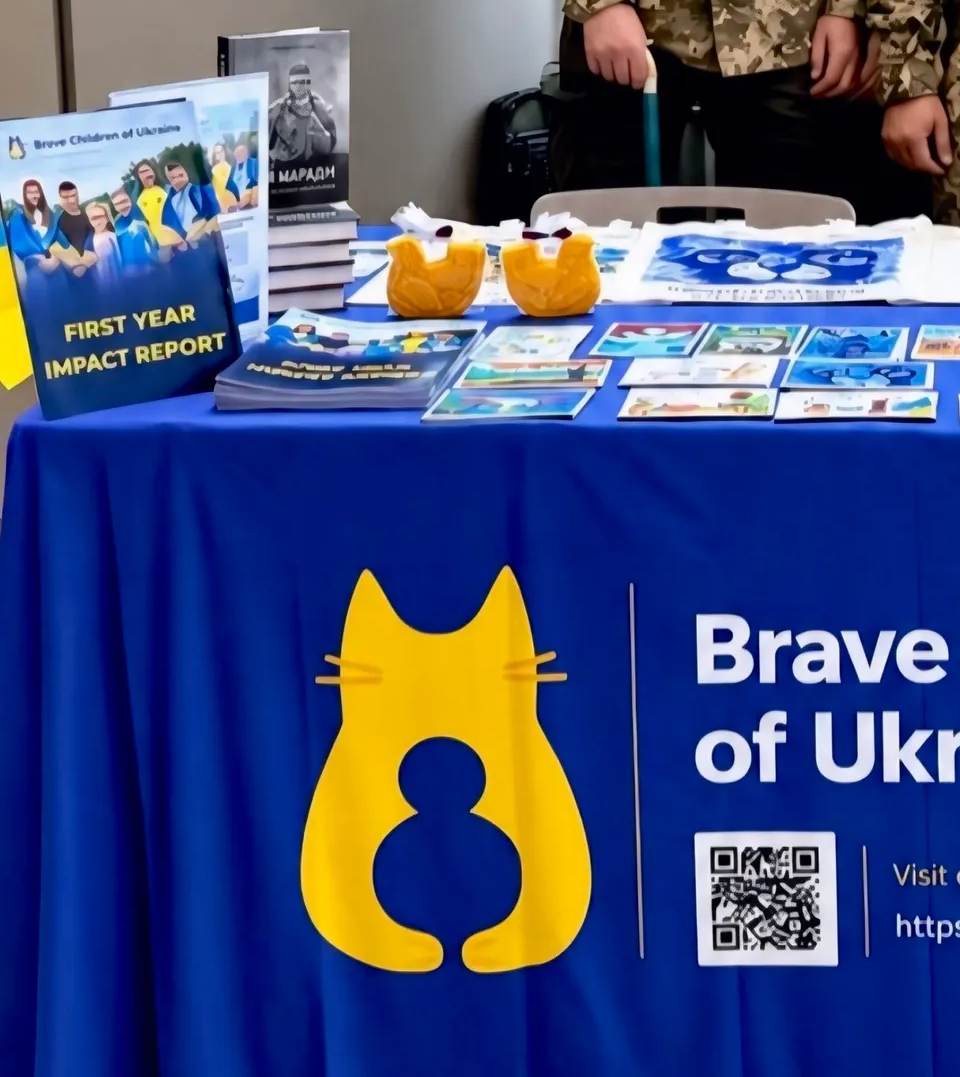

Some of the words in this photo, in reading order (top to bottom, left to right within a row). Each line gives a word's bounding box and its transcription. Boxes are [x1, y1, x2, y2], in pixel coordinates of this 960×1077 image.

[121, 127, 134, 140] of
[63, 314, 127, 343] FIRST
[132, 304, 196, 331] YEAR
[44, 348, 129, 380] IMPACT
[134, 332, 227, 365] REPORT
[695, 612, 950, 685] Brave
[693, 709, 788, 784] of
[892, 862, 948, 887] Visit
